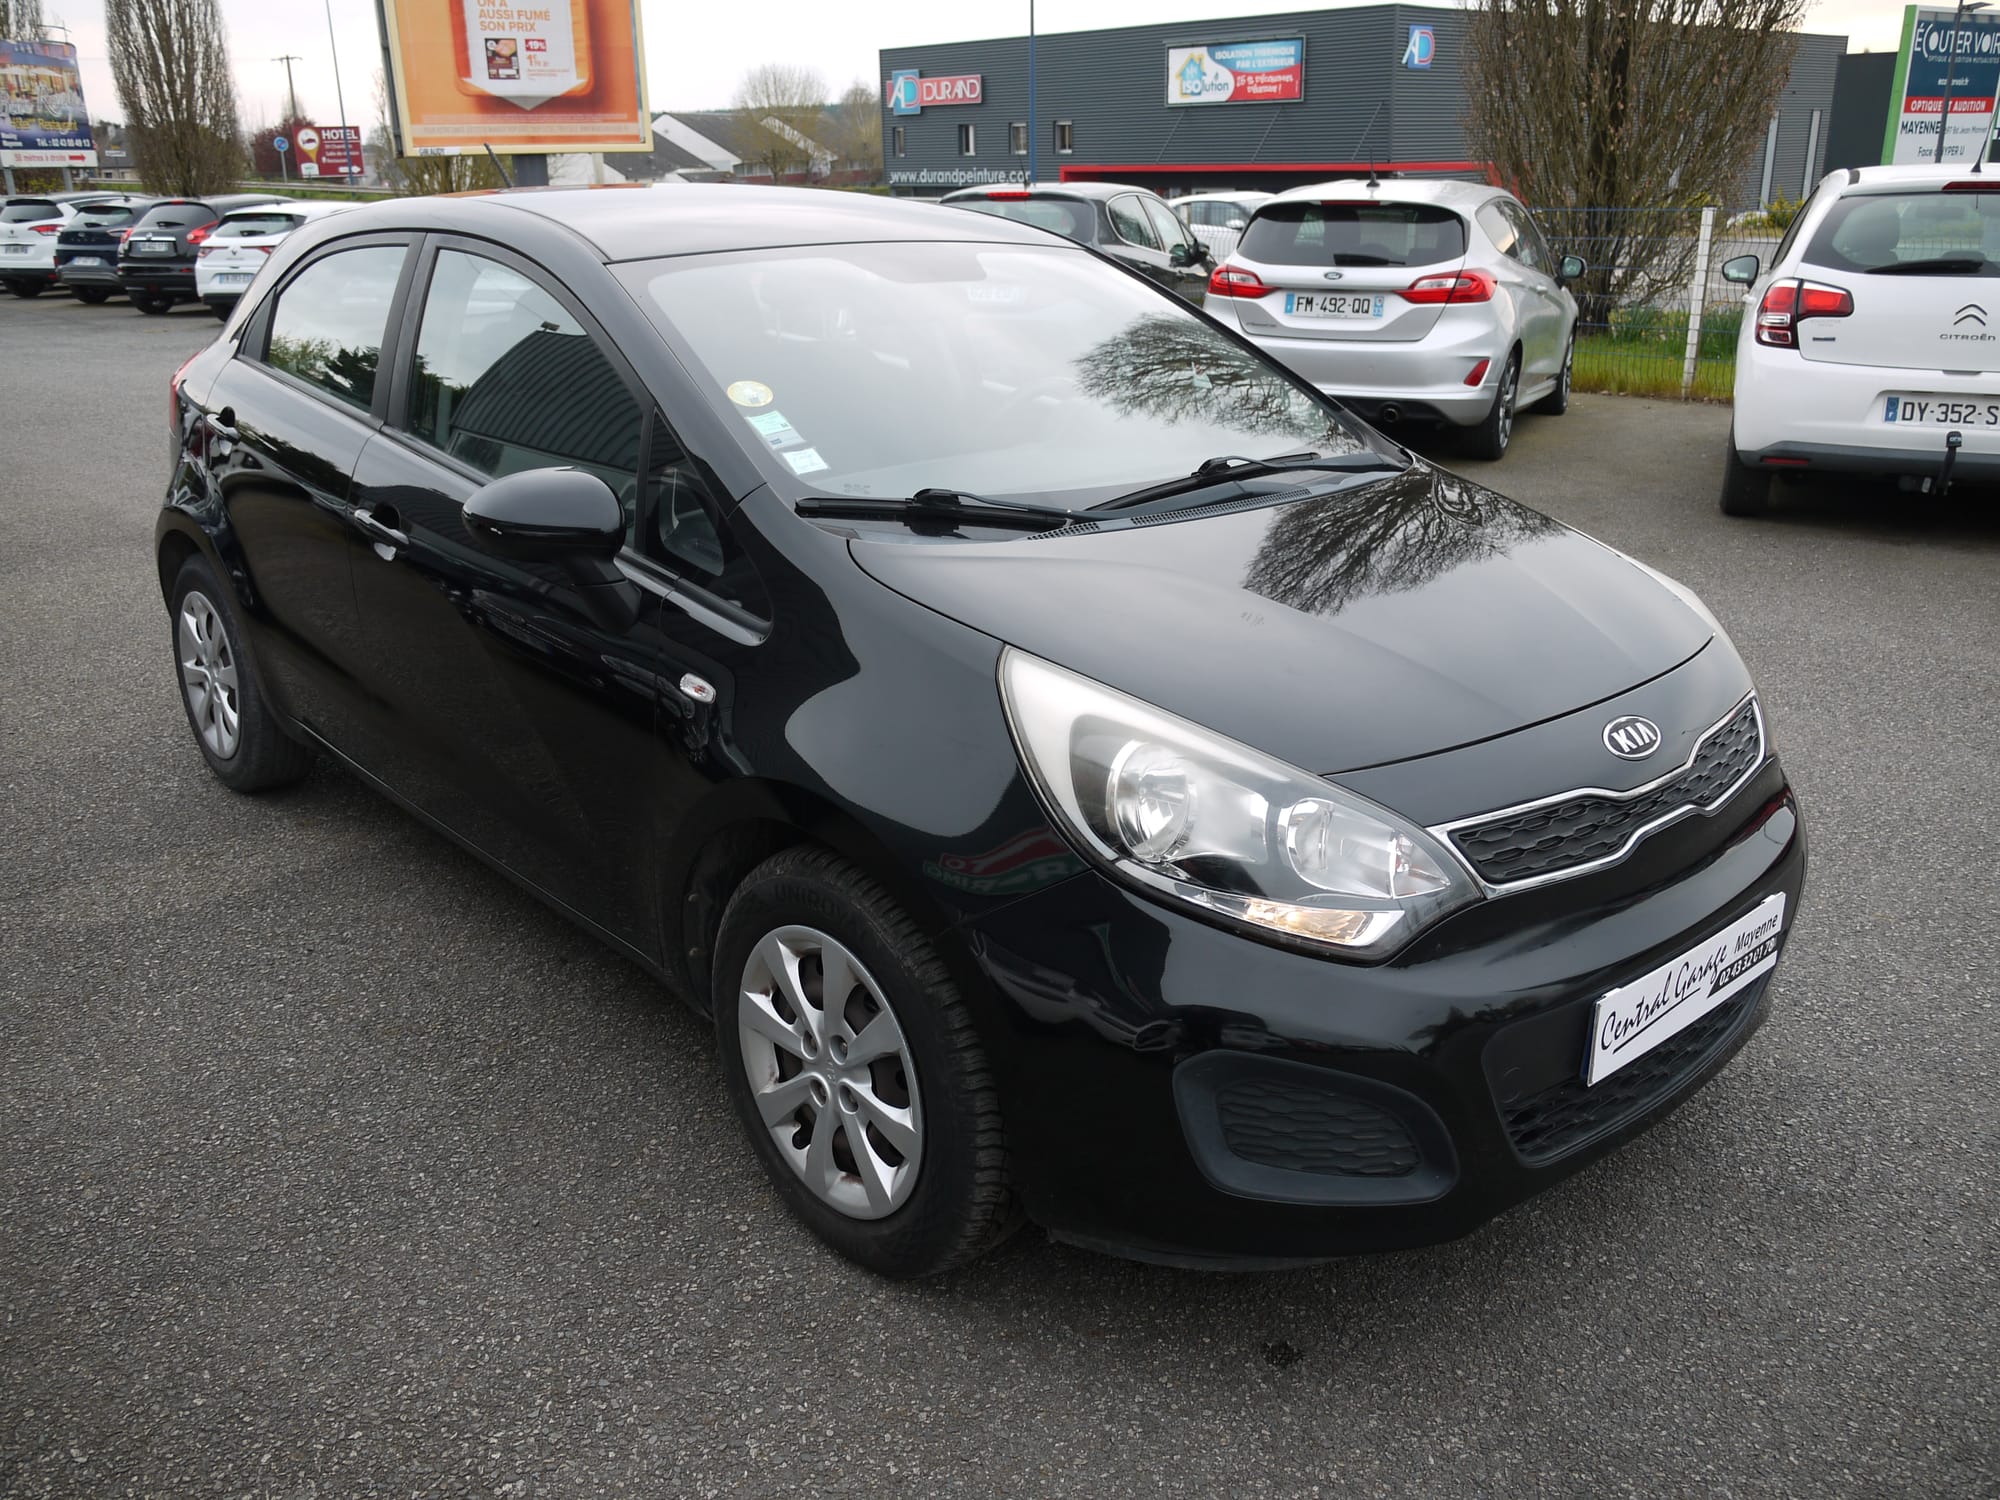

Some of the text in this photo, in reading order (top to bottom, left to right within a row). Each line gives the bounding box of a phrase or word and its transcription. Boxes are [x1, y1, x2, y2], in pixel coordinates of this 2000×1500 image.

[479, 8, 551, 21] AUSSI FUMÉ
[480, 21, 536, 32] SON PRIX
[1401, 26, 1435, 67] AD
[1914, 22, 2000, 58] ÉCOUTER VOIR
[888, 75, 980, 108] AD DURAND
[1910, 100, 1943, 112] OPTIQUE
[1953, 101, 1986, 111] AUDITION
[321, 129, 358, 140] HOTEL
[1900, 120, 1942, 134] MAYENNE
[1296, 296, 1371, 314] FM-492-QQ
[1940, 333, 1996, 341] CITROËN
[1610, 722, 1656, 753] KIA
[1601, 914, 1778, 1051] Central Garage Mayenne
